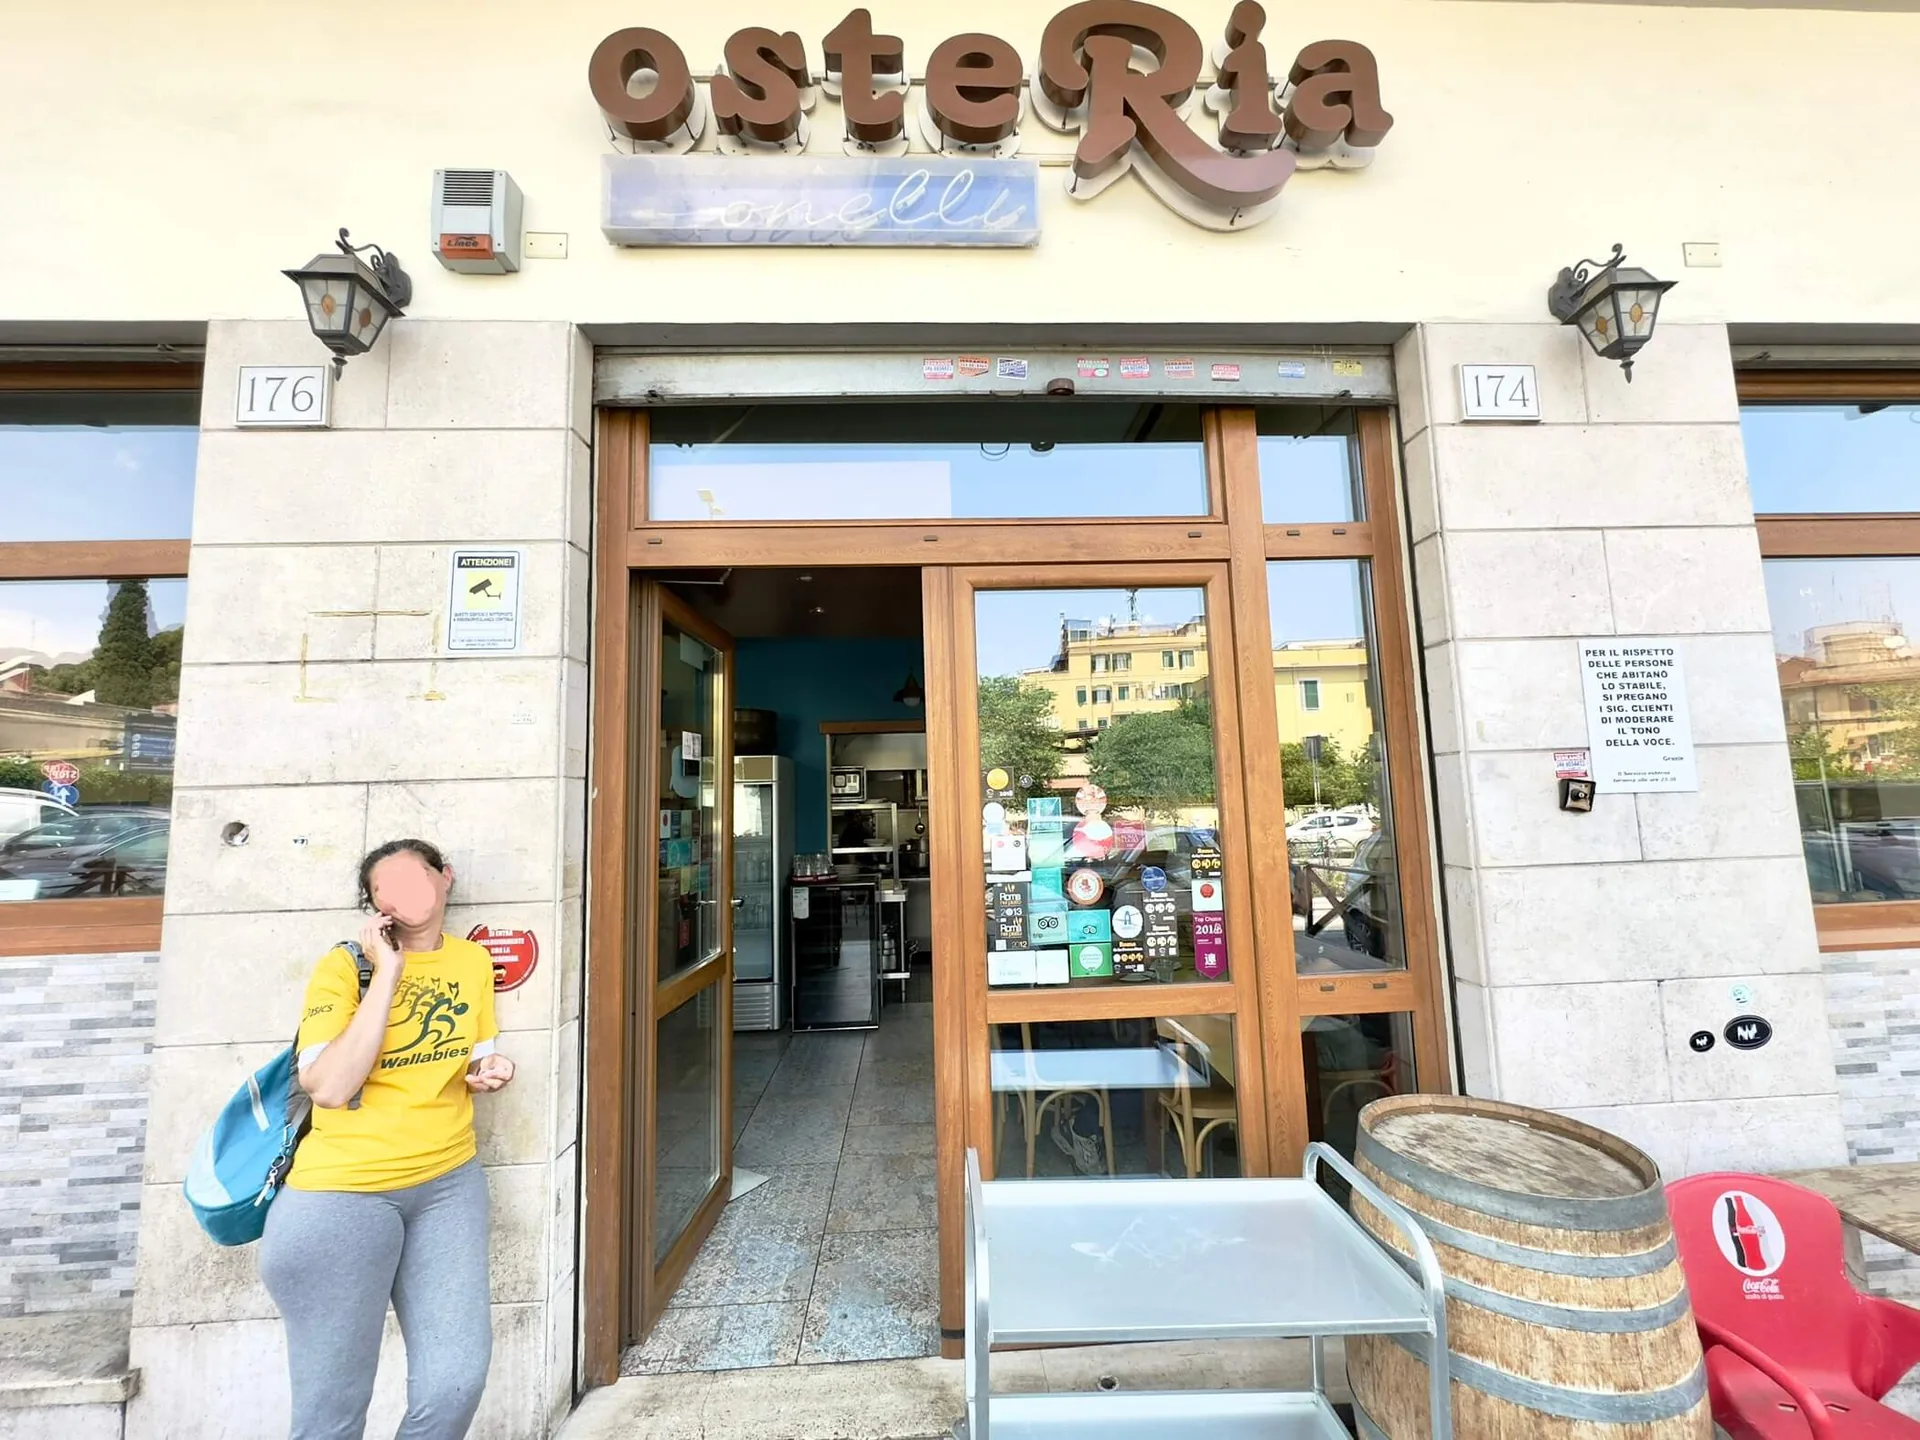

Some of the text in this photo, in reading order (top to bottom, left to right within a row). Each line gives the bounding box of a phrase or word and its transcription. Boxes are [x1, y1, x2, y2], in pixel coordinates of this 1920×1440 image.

[247, 375, 315, 412] 176
[1474, 374, 1530, 407] 174
[460, 557, 512, 567] ATTENZIONE!
[1585, 649, 1606, 657] PER
[1622, 648, 1674, 656] RISPETTO
[1625, 659, 1674, 667] PERSONE
[1621, 671, 1668, 679] ABITANO
[1619, 682, 1667, 690] STABILE,
[1616, 693, 1668, 701] PREGANO
[1631, 704, 1673, 712] CLIENTI
[1601, 716, 1612, 724] DI
[1606, 738, 1675, 747] DELLA VOCE.
[1000, 907, 1023, 916] 2013
[380, 1046, 469, 1069] Wallabies
